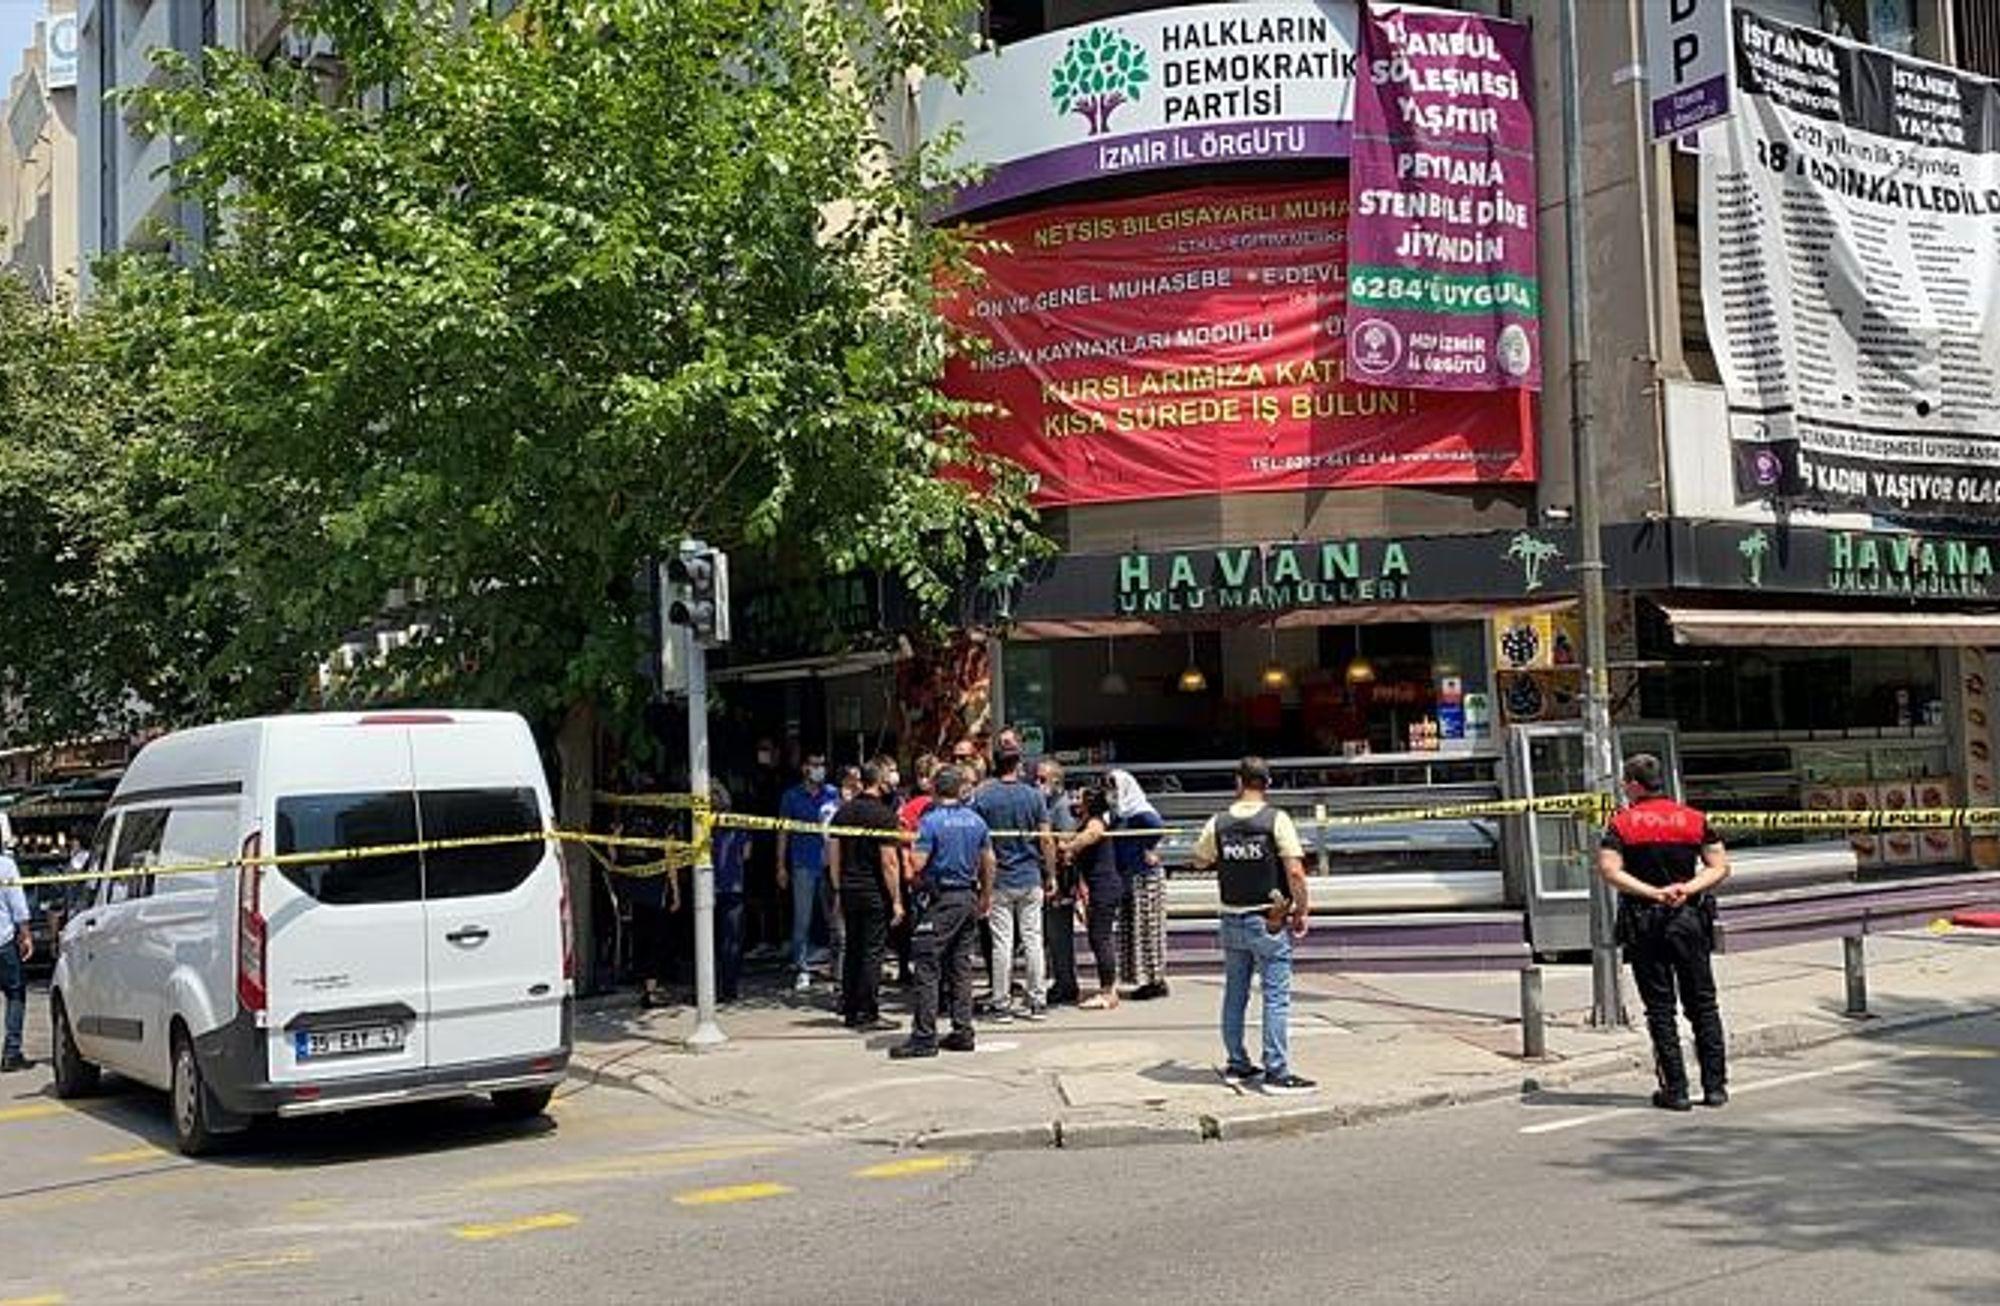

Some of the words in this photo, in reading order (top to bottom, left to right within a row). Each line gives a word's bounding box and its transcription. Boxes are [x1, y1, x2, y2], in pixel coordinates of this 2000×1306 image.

[1163, 17, 1326, 51] HALKLARIN
[1164, 48, 1356, 88] DEMOKRATİK
[1165, 83, 1282, 123] PARTİSİ
[1100, 137, 1167, 169] İZMİR
[1174, 134, 1194, 160] İL
[1478, 190, 1528, 229] DİDE
[1035, 284, 1102, 311] GENEL
[1108, 267, 1231, 300] MUHASEBE
[1042, 362, 1264, 403] KURSLARIMIZA
[1045, 409, 1108, 437] KISA
[1116, 397, 1242, 433] SÜREDE
[1253, 390, 1281, 424] İŞ
[1291, 389, 1399, 419] BULUN
[1871, 471, 1954, 508] YAŞIYOR
[1120, 542, 1410, 593] HAVANA
[1831, 531, 1994, 576] HAVANA
